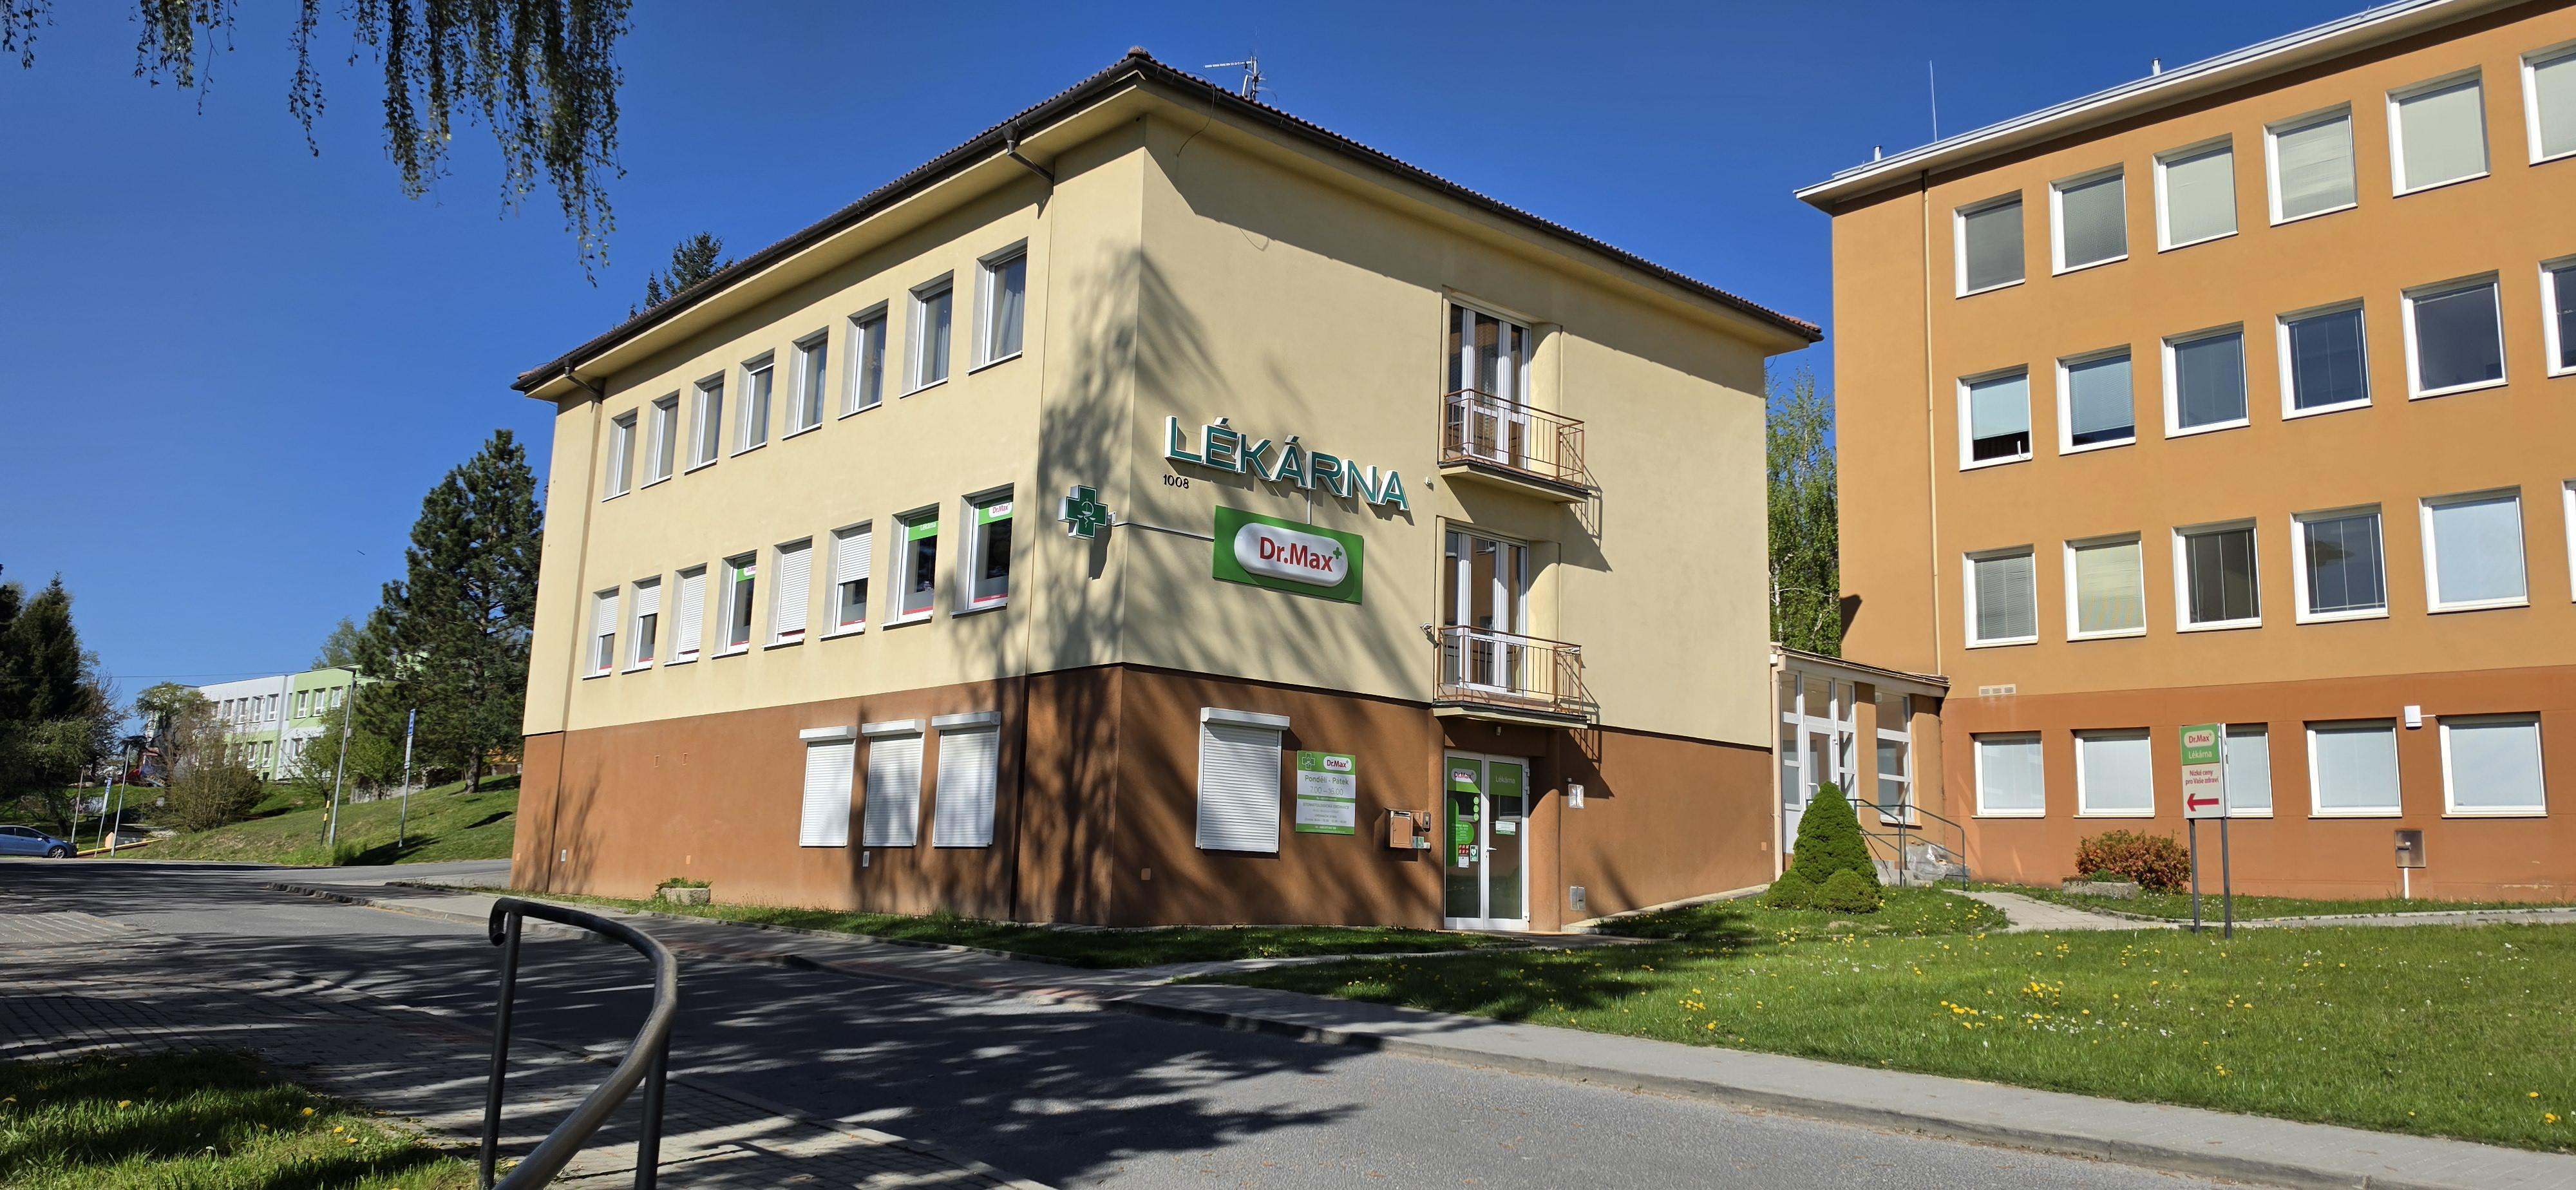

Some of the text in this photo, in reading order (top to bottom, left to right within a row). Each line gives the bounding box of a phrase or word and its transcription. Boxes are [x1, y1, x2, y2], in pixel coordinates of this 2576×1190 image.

[1165, 416, 1409, 511] LÉKÁRNA
[1163, 474, 1189, 489] 1008
[1260, 536, 1334, 572] Dr.Max
[2188, 735, 2210, 743] Dr.Max
[2188, 750, 2212, 759] Lékárna
[1327, 759, 1347, 768] Dr.Max
[1305, 775, 1327, 783] Pondělí
[1495, 774, 1515, 784] Lékárna
